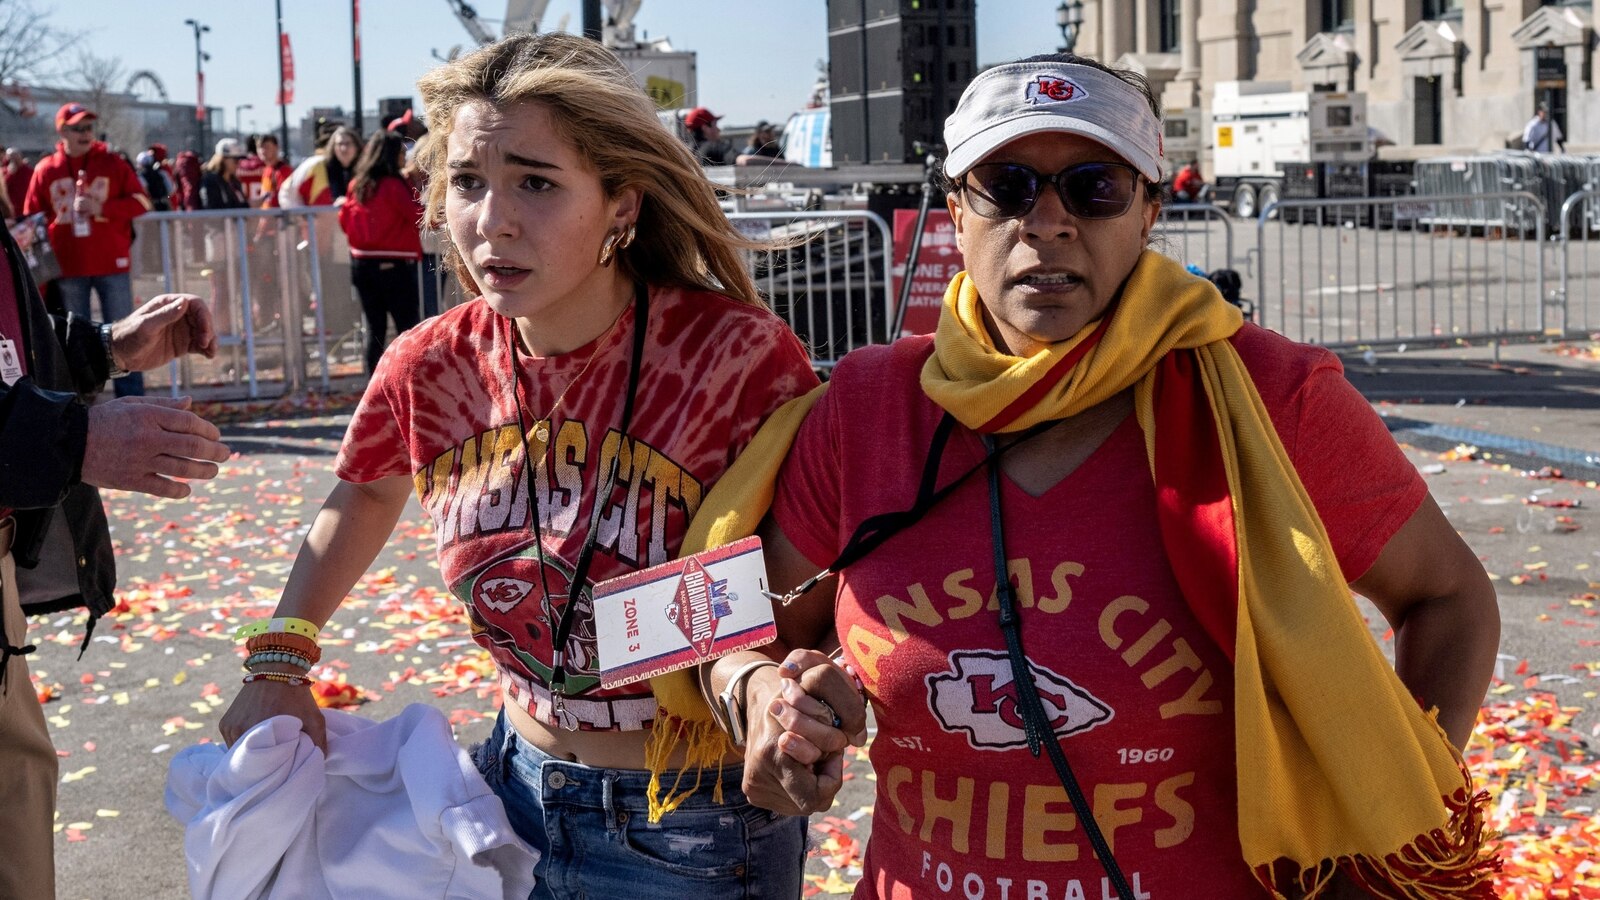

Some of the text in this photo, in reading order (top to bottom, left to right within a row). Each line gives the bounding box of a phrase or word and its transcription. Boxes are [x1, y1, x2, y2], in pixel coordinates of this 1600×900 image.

[623, 598, 641, 652] ZONE 3
[684, 570, 713, 643] CHAMPIONS
[847, 557, 1223, 720] ANSAS CITY
[890, 736, 1175, 765] EST. 1960
[887, 765, 1196, 862] CHIEFS
[920, 851, 1151, 900] FOOTBALL
